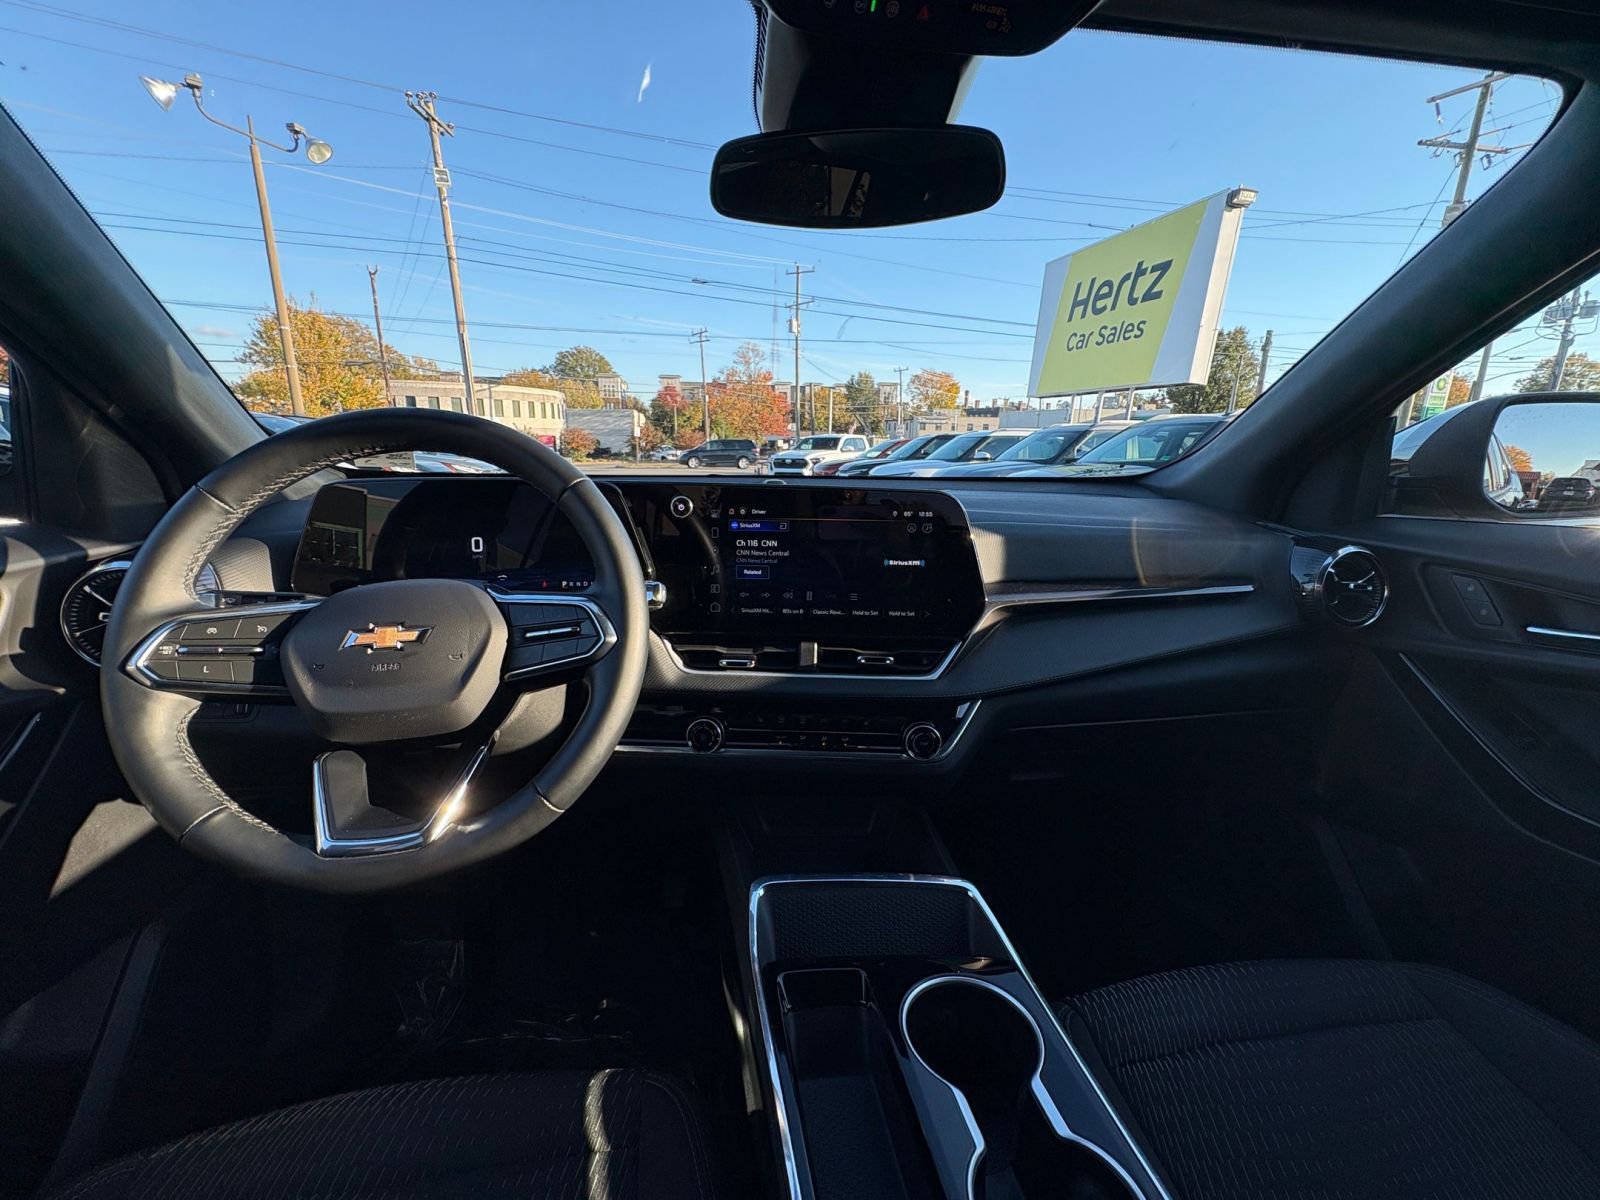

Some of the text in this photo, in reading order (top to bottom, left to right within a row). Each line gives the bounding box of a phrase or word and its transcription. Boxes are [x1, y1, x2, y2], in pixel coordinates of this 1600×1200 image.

[1067, 258, 1174, 323] Hertz
[1066, 320, 1148, 352] Car Sales
[471, 536, 484, 553] 0
[735, 539, 746, 547] Ch
[761, 539, 778, 547] CNN
